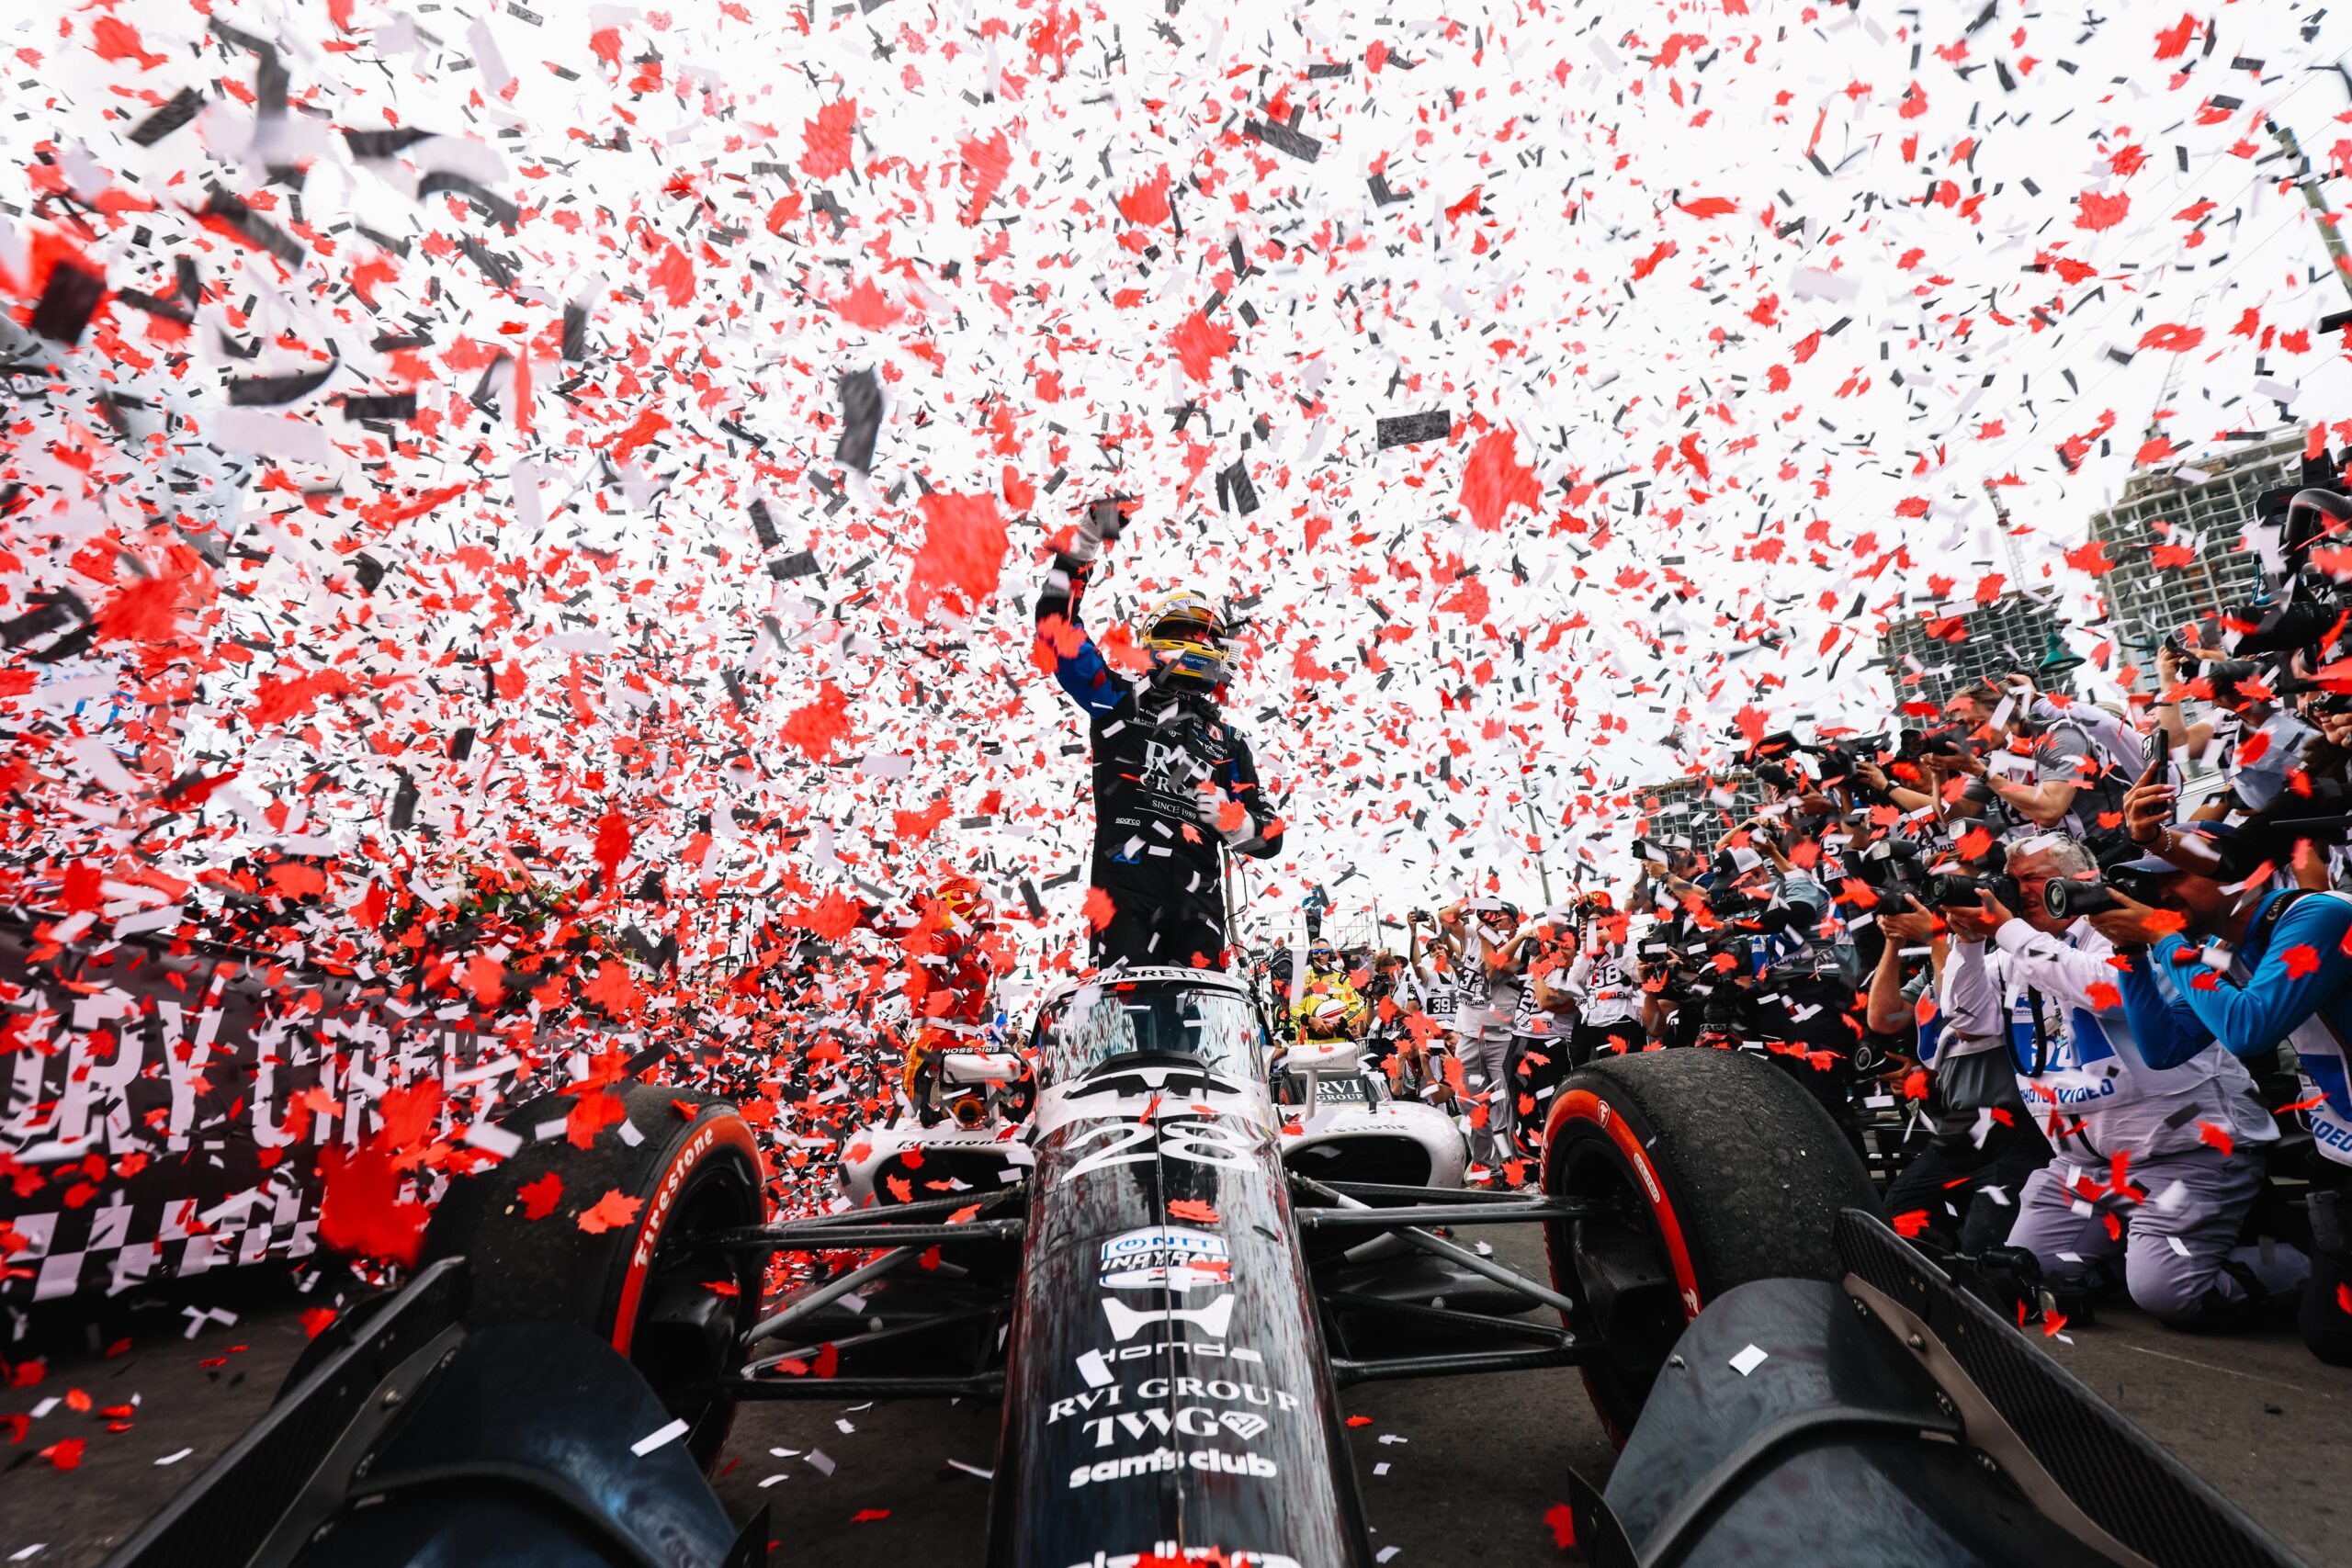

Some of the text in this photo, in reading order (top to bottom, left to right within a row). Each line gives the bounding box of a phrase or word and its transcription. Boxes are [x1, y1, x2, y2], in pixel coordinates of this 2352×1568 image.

[1151, 799, 1197, 819] SINCE 1989
[1432, 997, 1460, 1014] 39
[1316, 1078, 1363, 1095] RVI
[1316, 1092, 1364, 1101] GROUP
[1060, 1121, 1260, 1184] 28
[634, 1127, 714, 1269] Firestone
[1152, 1236, 1213, 1248] NTT
[1046, 1377, 1300, 1425] RVI GROUP
[1082, 1406, 1220, 1449] TWG
[1188, 1448, 1278, 1478] club
